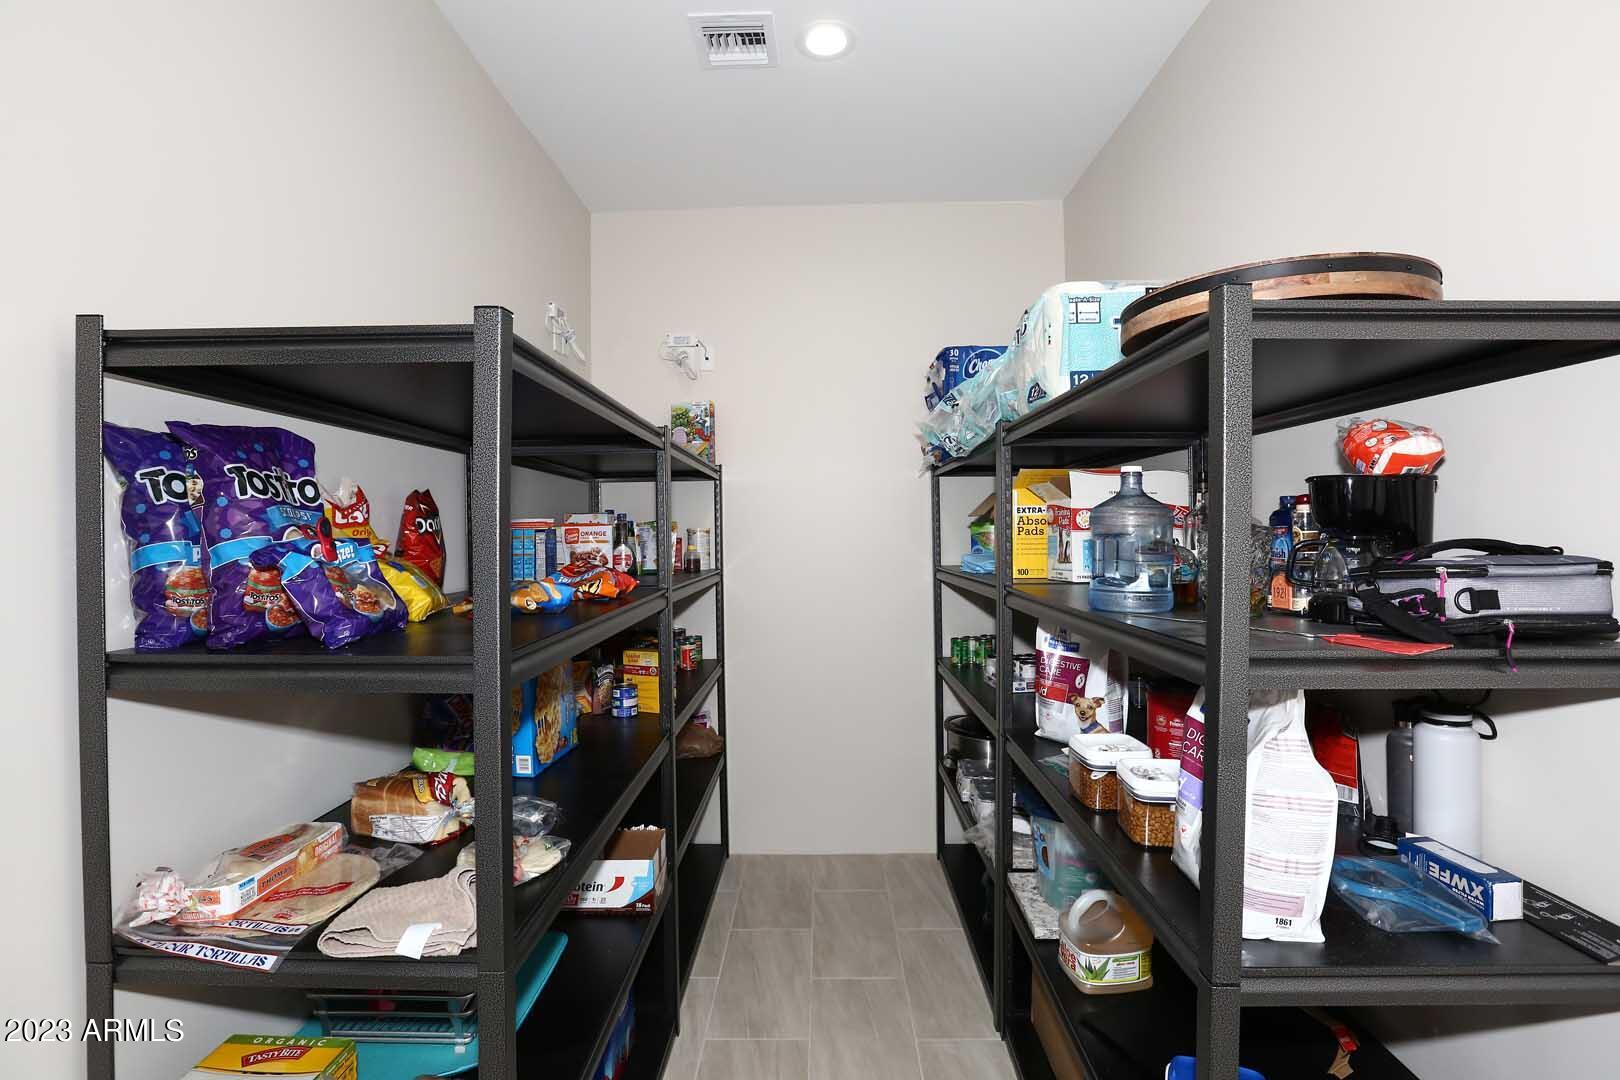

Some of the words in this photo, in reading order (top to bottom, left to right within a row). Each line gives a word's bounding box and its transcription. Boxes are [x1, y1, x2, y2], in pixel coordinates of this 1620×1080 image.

[1017, 506, 1046, 514] EXTRA-
[1017, 526, 1045, 536] Pads
[1273, 586, 1287, 599] 1921
[1429, 861, 1484, 901] XWFE
[1275, 917, 1293, 927] 1861
[196, 945, 268, 967] TORTILLAS
[253, 1037, 328, 1047] ORGANIC
